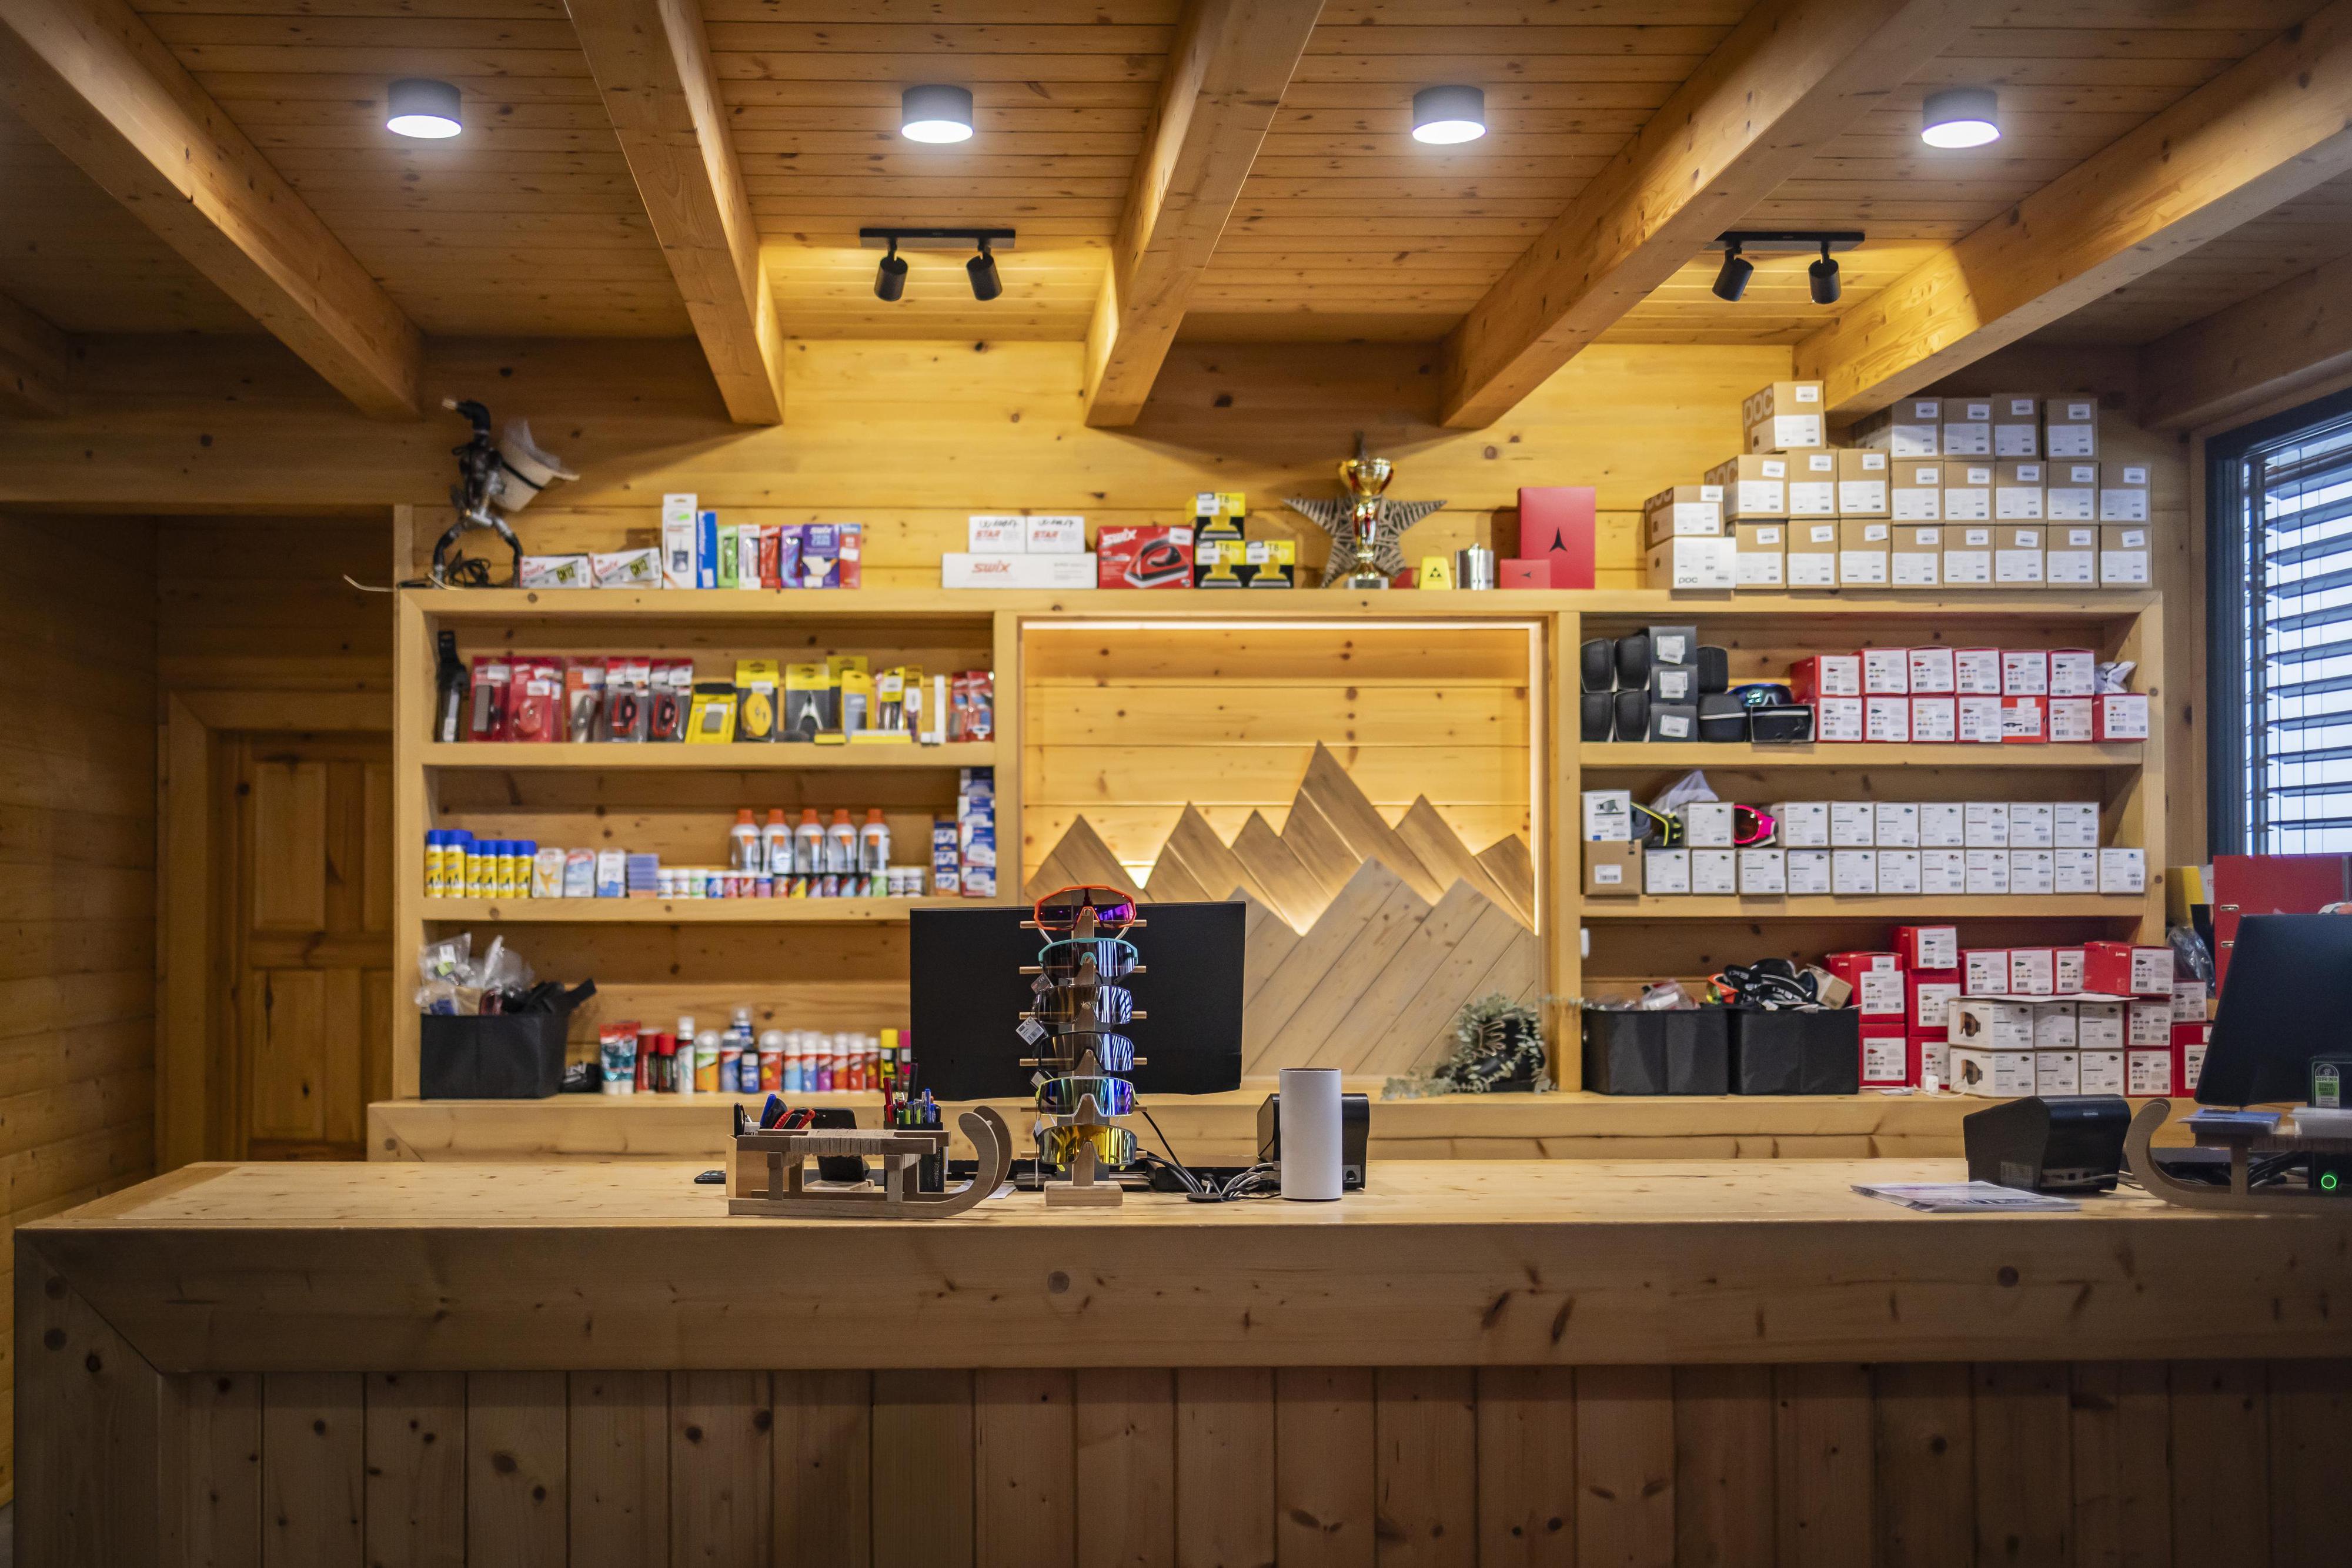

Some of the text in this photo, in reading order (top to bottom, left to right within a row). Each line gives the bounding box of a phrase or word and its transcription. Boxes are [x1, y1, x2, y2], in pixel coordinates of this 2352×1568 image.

[975, 530, 1001, 538] STAR
[1034, 530, 1059, 539] STAR
[973, 560, 1011, 573] swix
